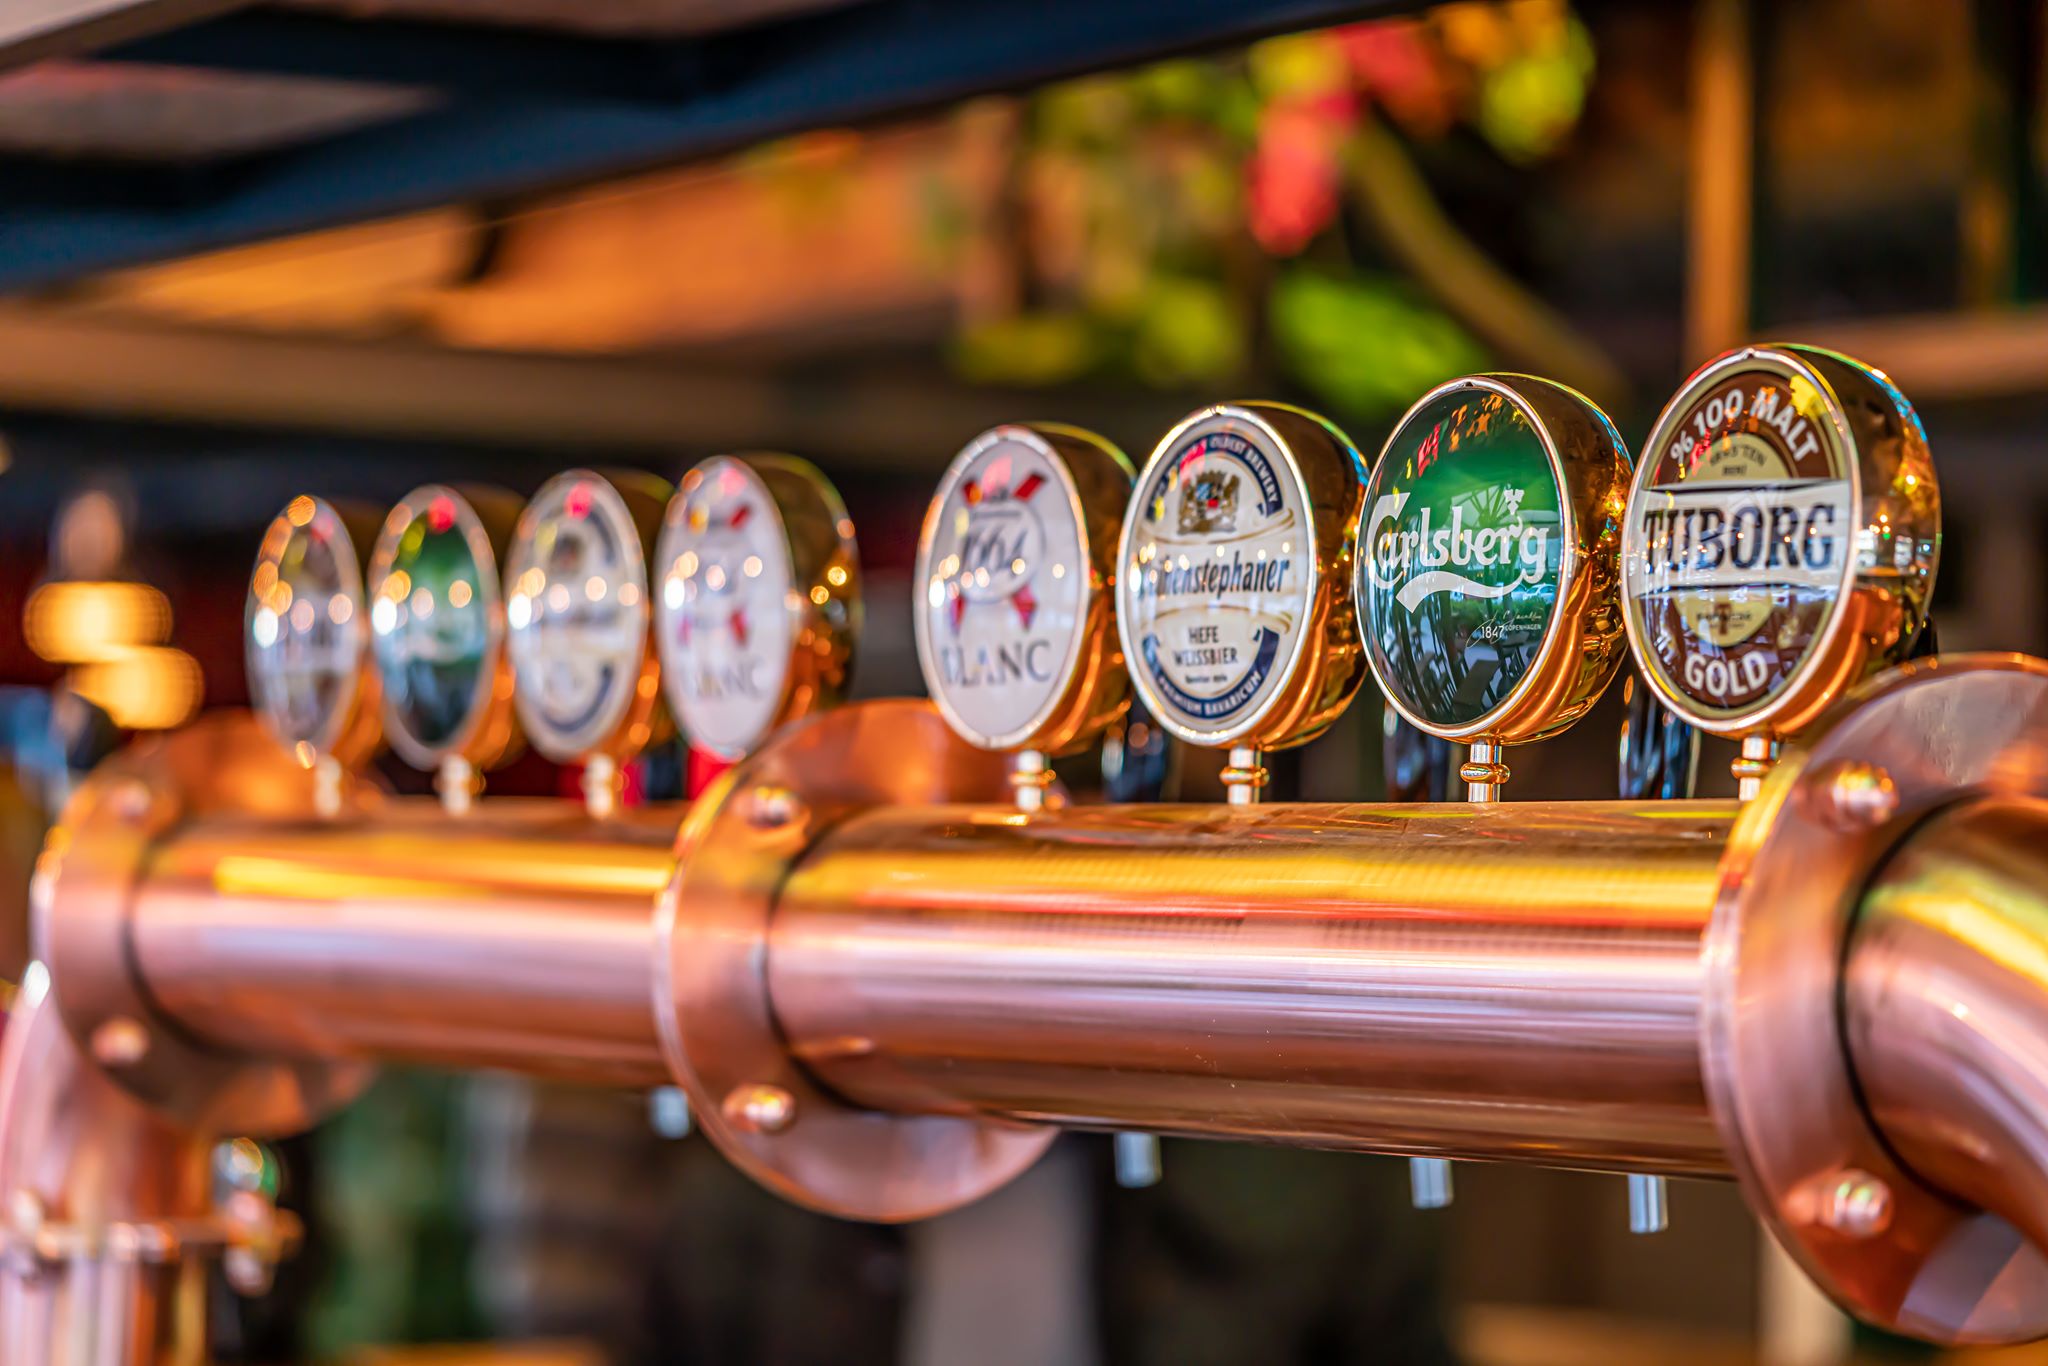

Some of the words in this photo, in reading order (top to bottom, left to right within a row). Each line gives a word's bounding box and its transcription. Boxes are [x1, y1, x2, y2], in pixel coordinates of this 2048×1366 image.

[1750, 387, 1819, 461] MALT
[1366, 490, 1549, 592] Carlsberg
[1643, 504, 1835, 574] TUBORG
[1188, 625, 1220, 643] HEFE
[1481, 625, 1505, 639] 1847
[1505, 624, 1542, 632] COPENHAGEN
[1685, 651, 1768, 696] GOLD
